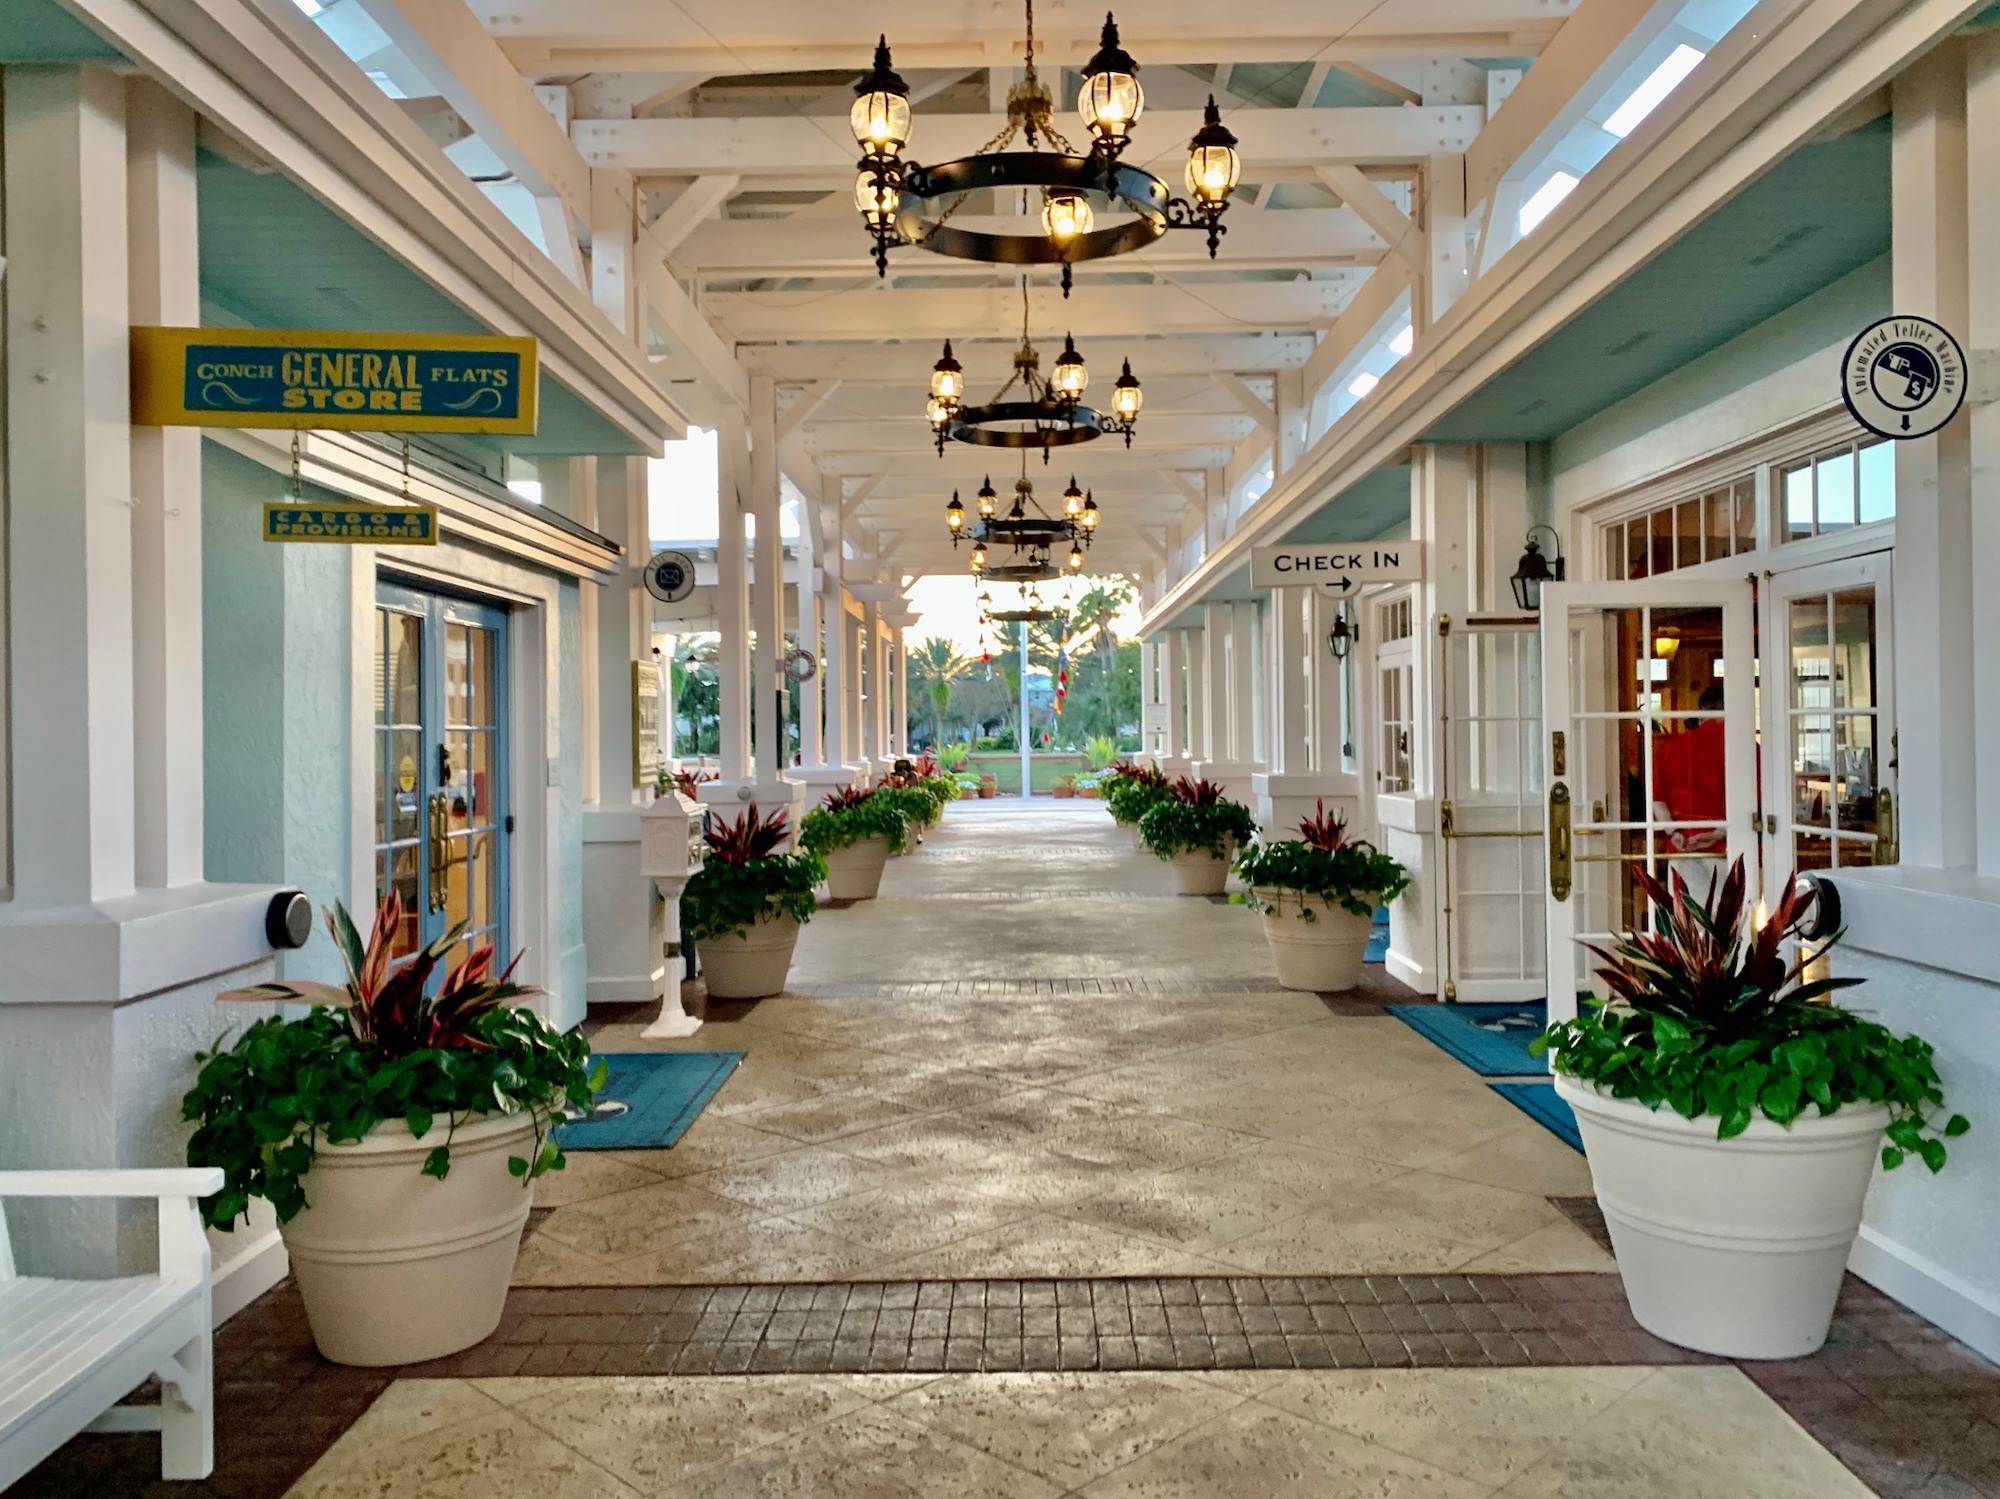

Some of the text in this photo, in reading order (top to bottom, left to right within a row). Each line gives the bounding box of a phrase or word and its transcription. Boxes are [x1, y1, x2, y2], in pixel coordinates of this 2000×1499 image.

[1893, 322, 1933, 343] Teller
[1935, 340, 1959, 394] Machine
[196, 351, 509, 389] CONCH GENERAL FLATS
[281, 387, 423, 411] STORE
[276, 511, 422, 526] CARGO &
[275, 523, 423, 538] PROVISIONS
[1273, 551, 1400, 572] CHECK IN
